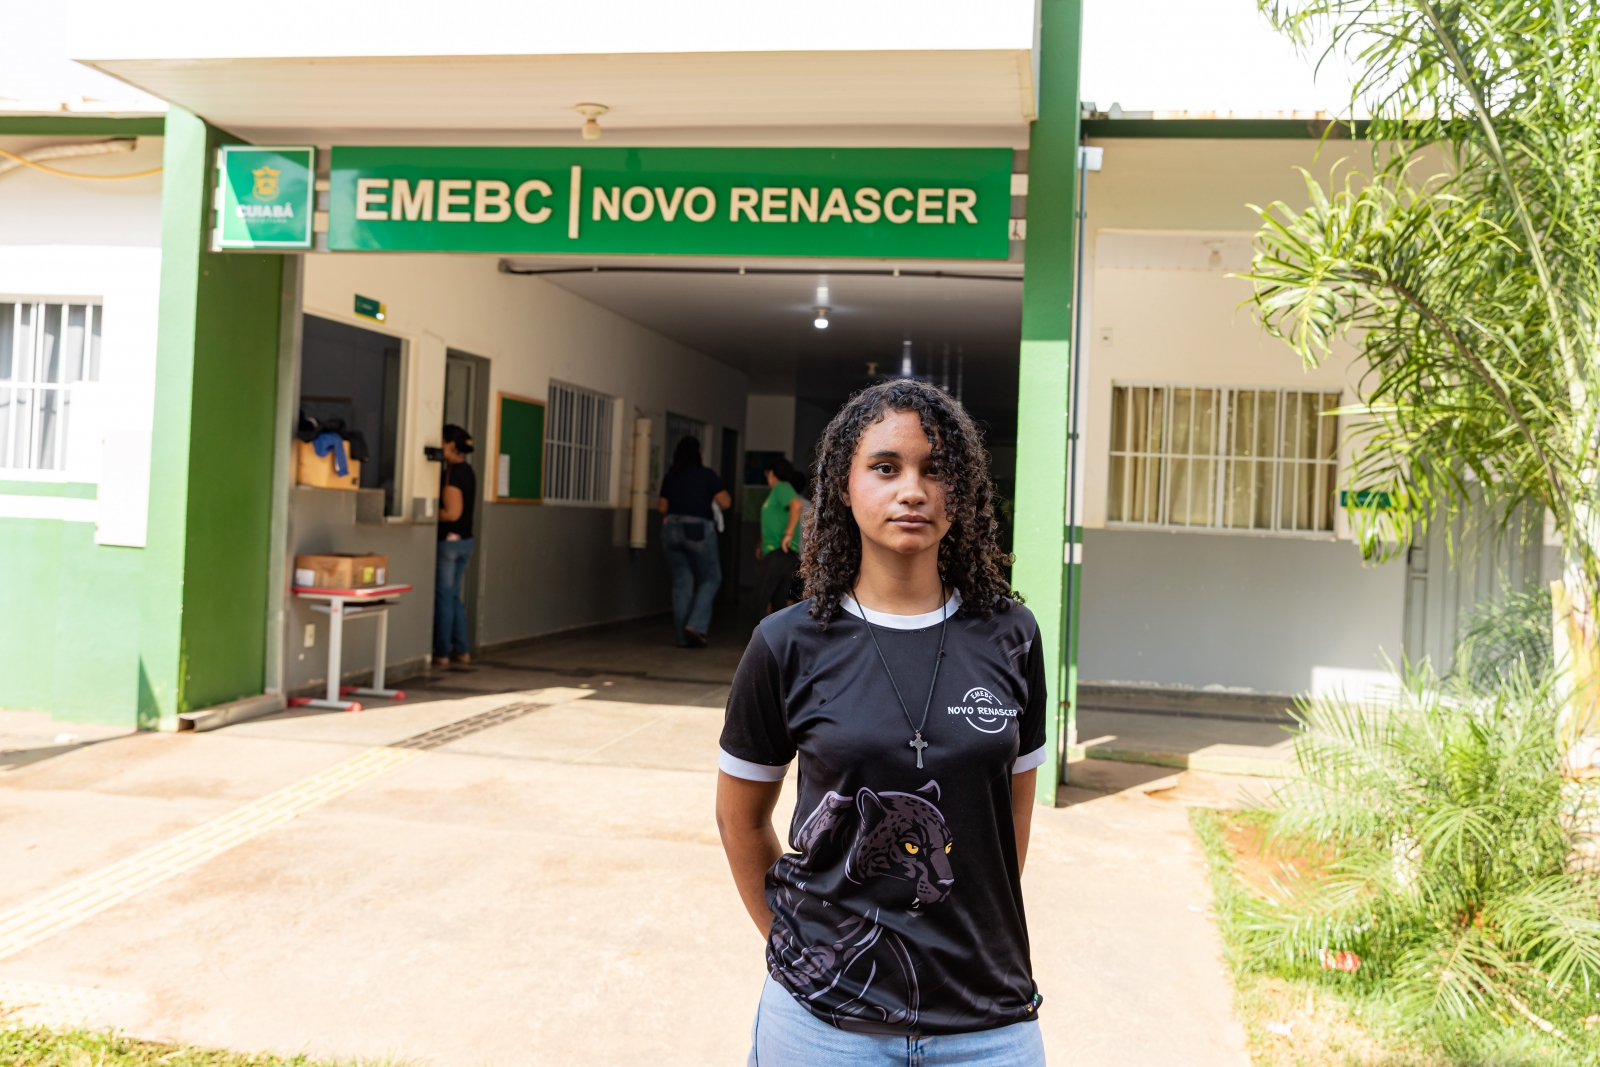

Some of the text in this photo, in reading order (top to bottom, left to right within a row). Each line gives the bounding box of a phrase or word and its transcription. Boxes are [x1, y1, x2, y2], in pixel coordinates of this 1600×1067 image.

[355, 178, 978, 224] EMEBC NOVO RENASCER
[235, 202, 294, 218] CUIABÁ
[970, 690, 993, 701] EMEBC
[947, 706, 974, 715] NOVO
